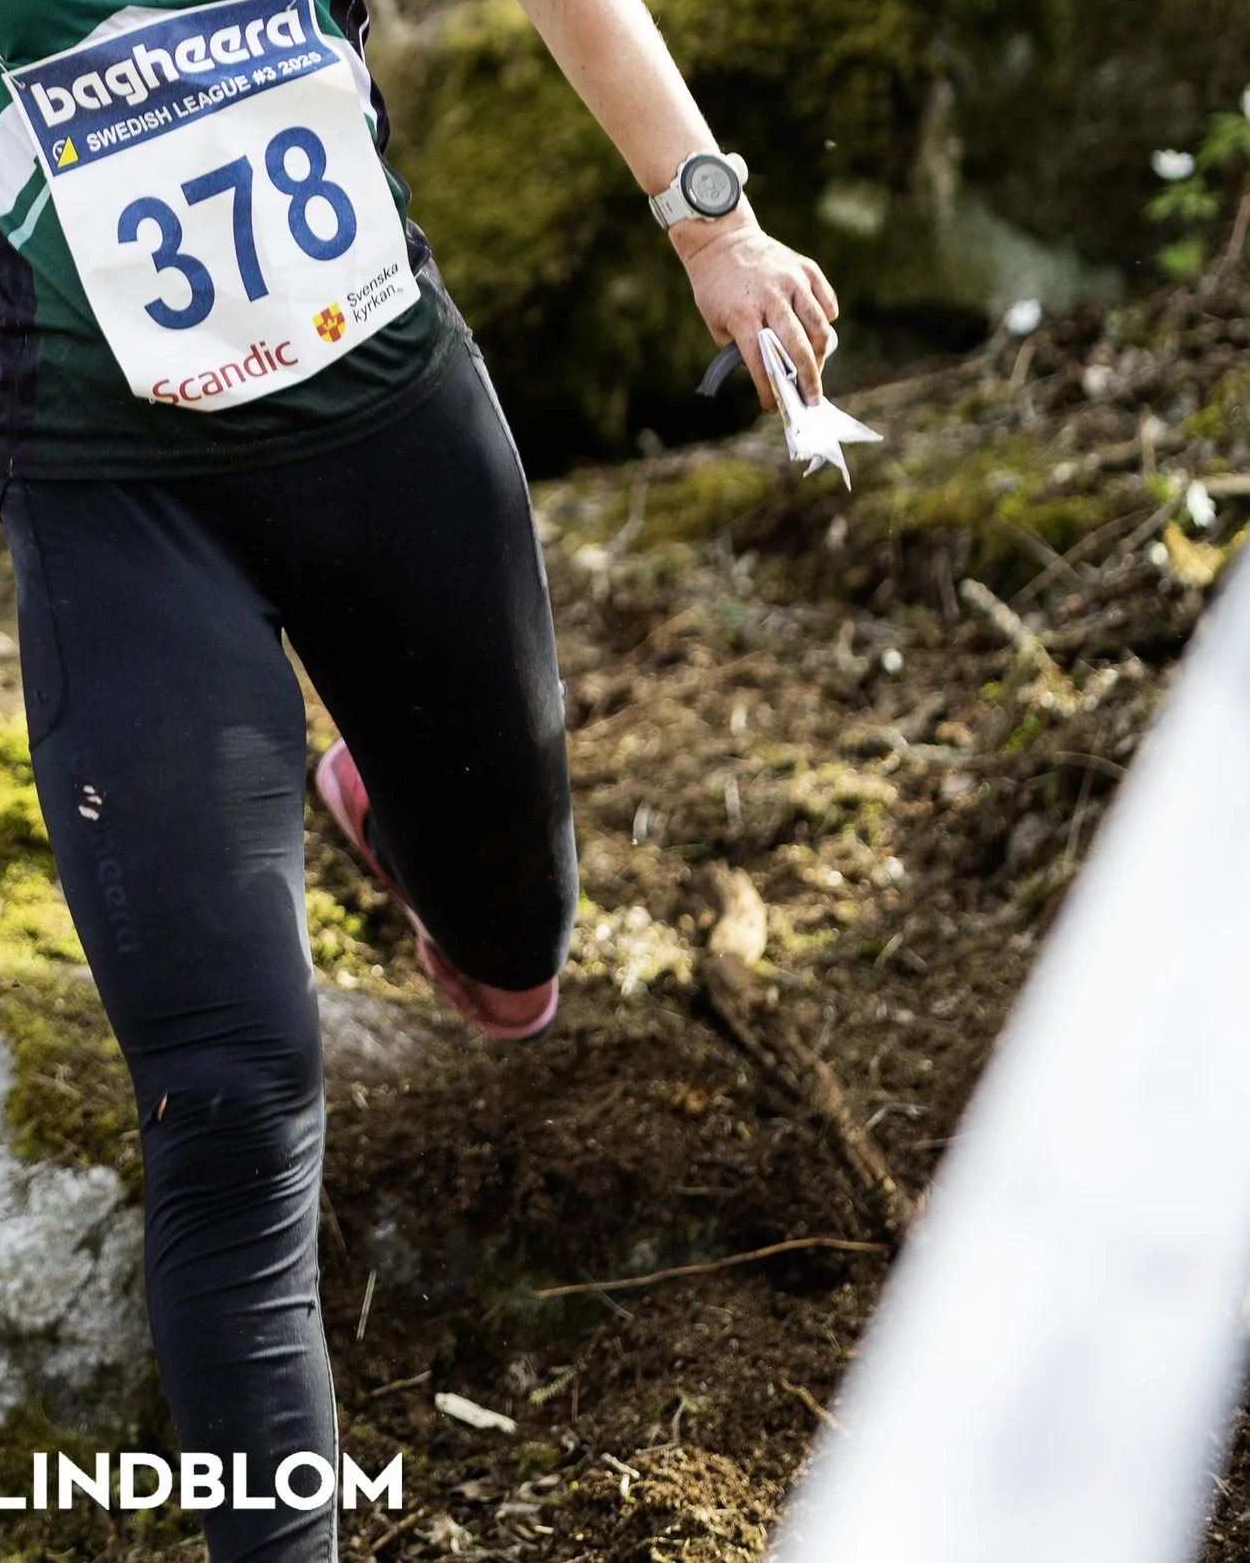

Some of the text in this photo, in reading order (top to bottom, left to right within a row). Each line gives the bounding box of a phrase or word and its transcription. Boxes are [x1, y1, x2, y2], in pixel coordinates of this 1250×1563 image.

[30, 8, 307, 128] bagheera
[86, 50, 323, 153] SWEDISH LEAGUE #3 2025
[117, 126, 357, 331] 378
[347, 262, 399, 308] Svenska
[352, 284, 396, 323] kyrkan
[152, 339, 299, 406] Scandic
